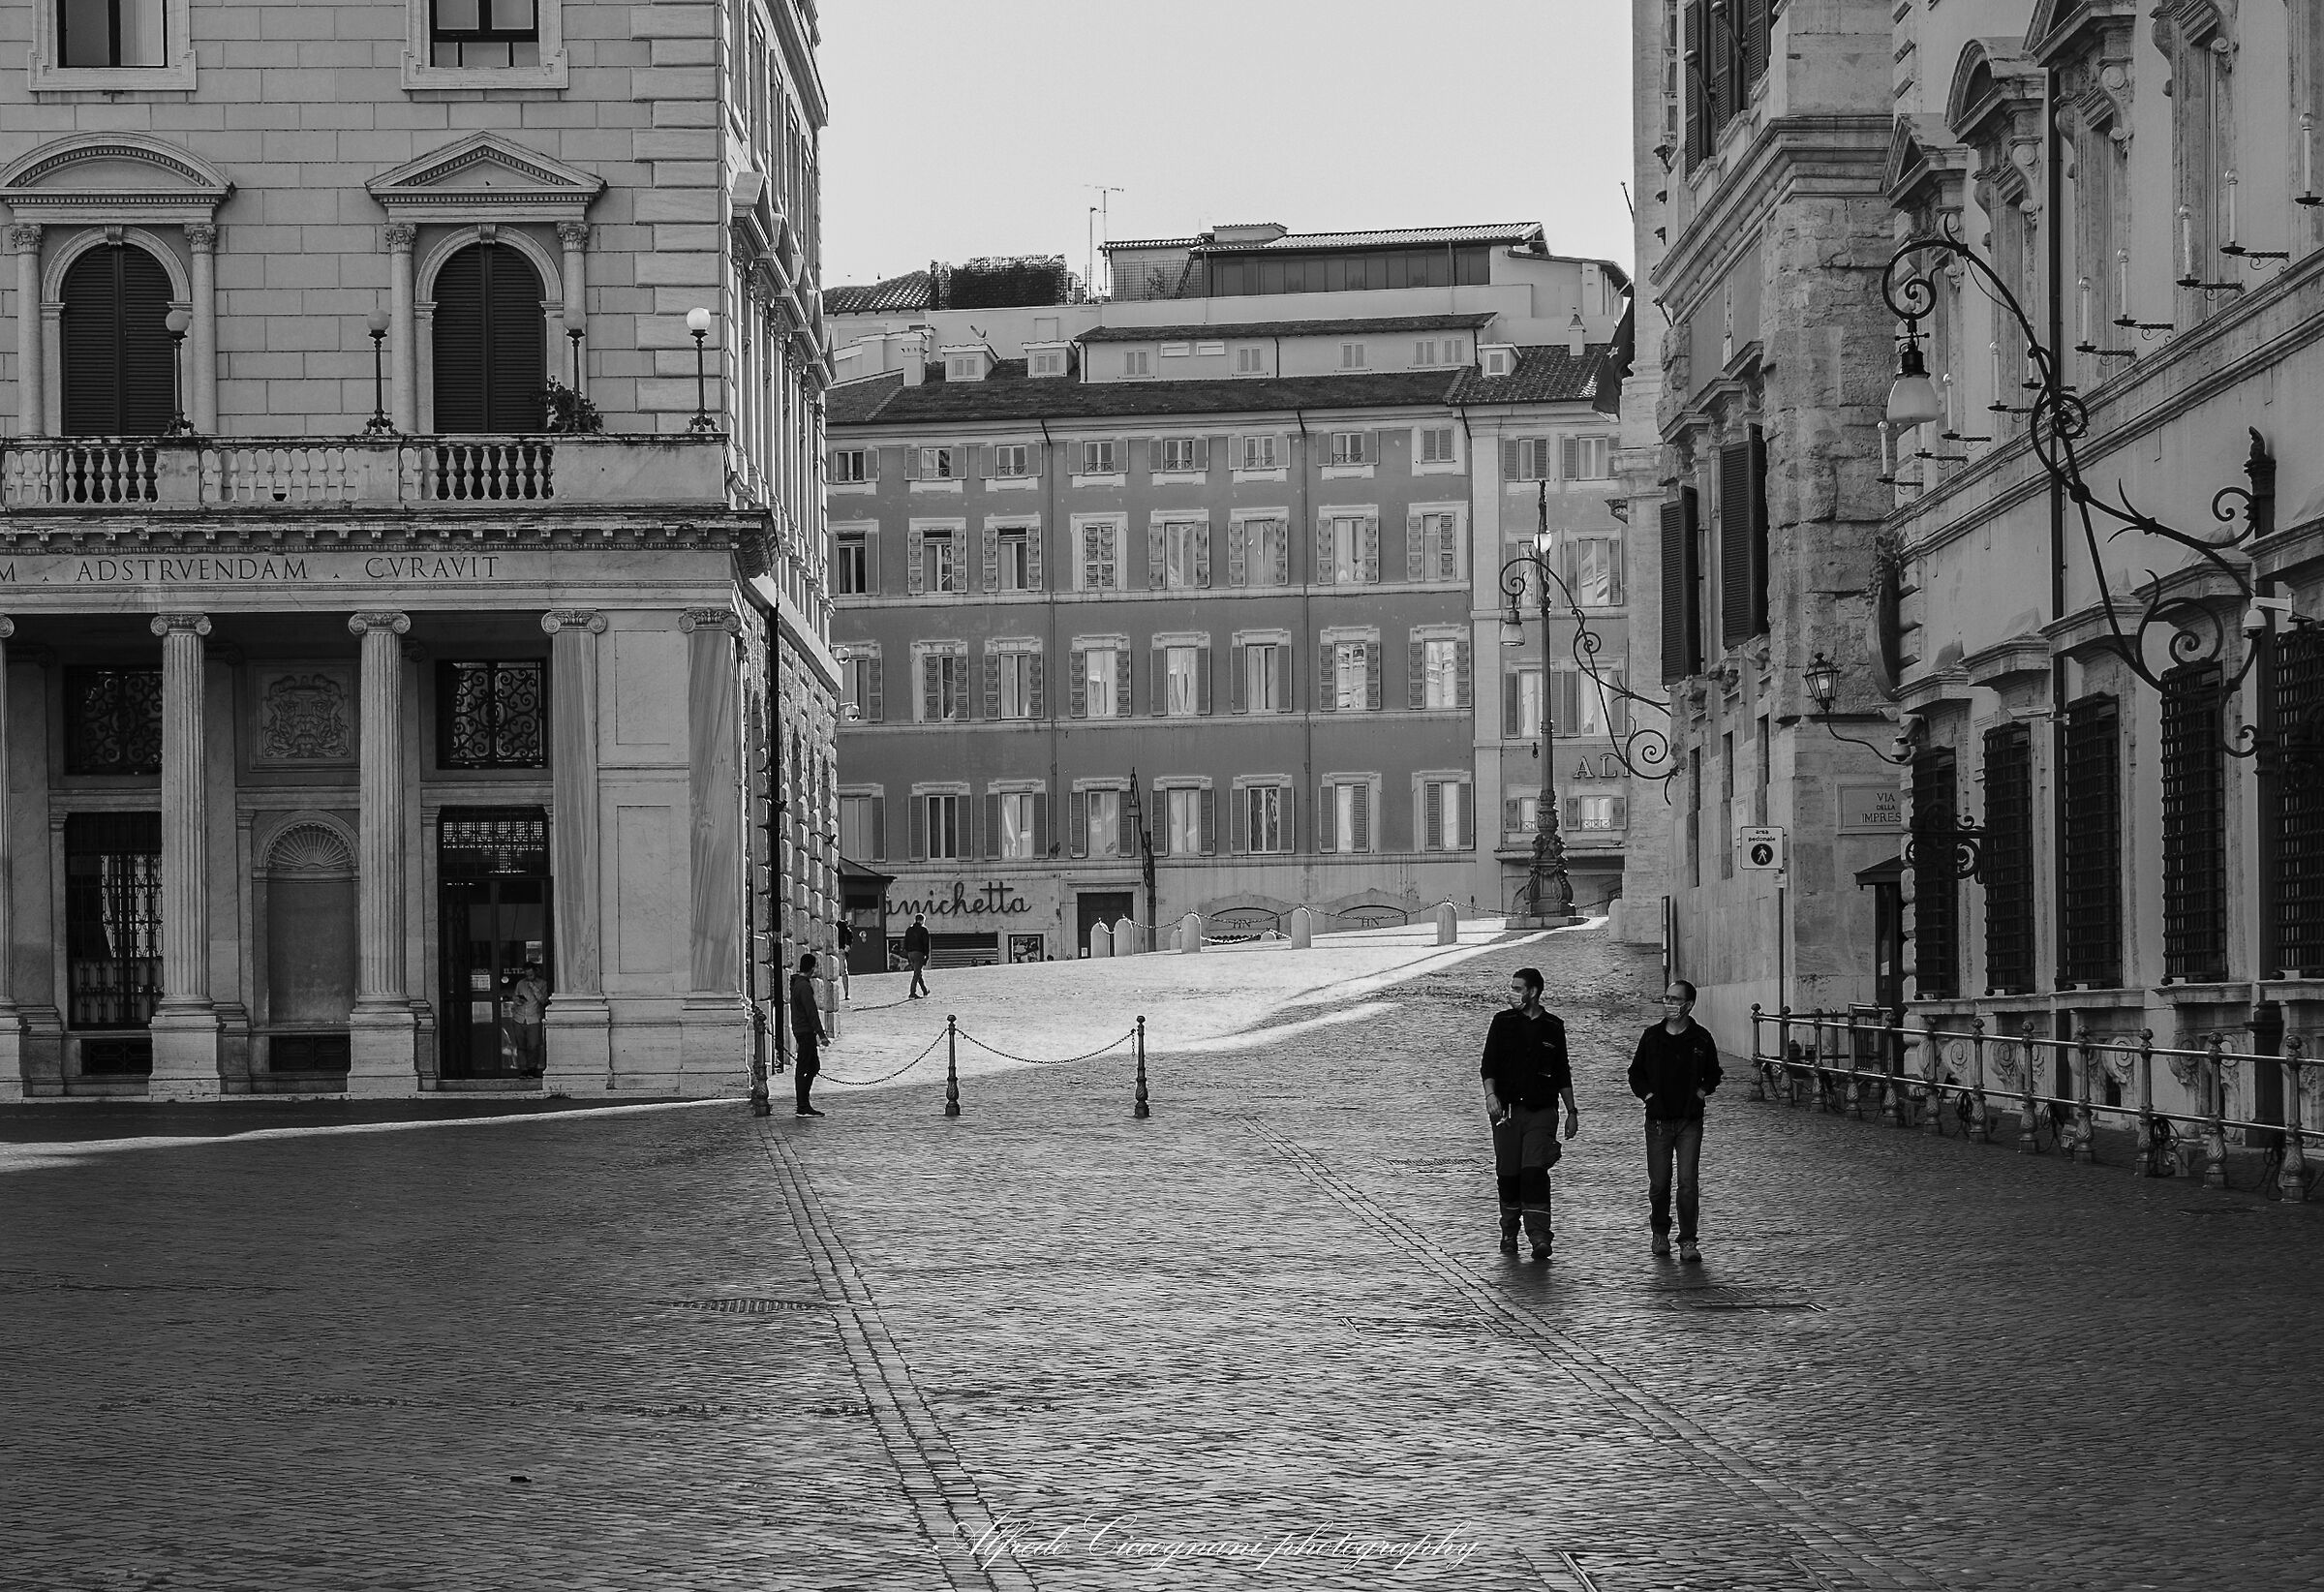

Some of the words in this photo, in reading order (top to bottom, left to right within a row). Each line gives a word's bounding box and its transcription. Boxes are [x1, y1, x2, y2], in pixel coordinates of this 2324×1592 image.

[76, 558, 308, 581] ADSTRVENDAM
[364, 556, 499, 578] CVRAVIT
[1876, 792, 1895, 802] VIA
